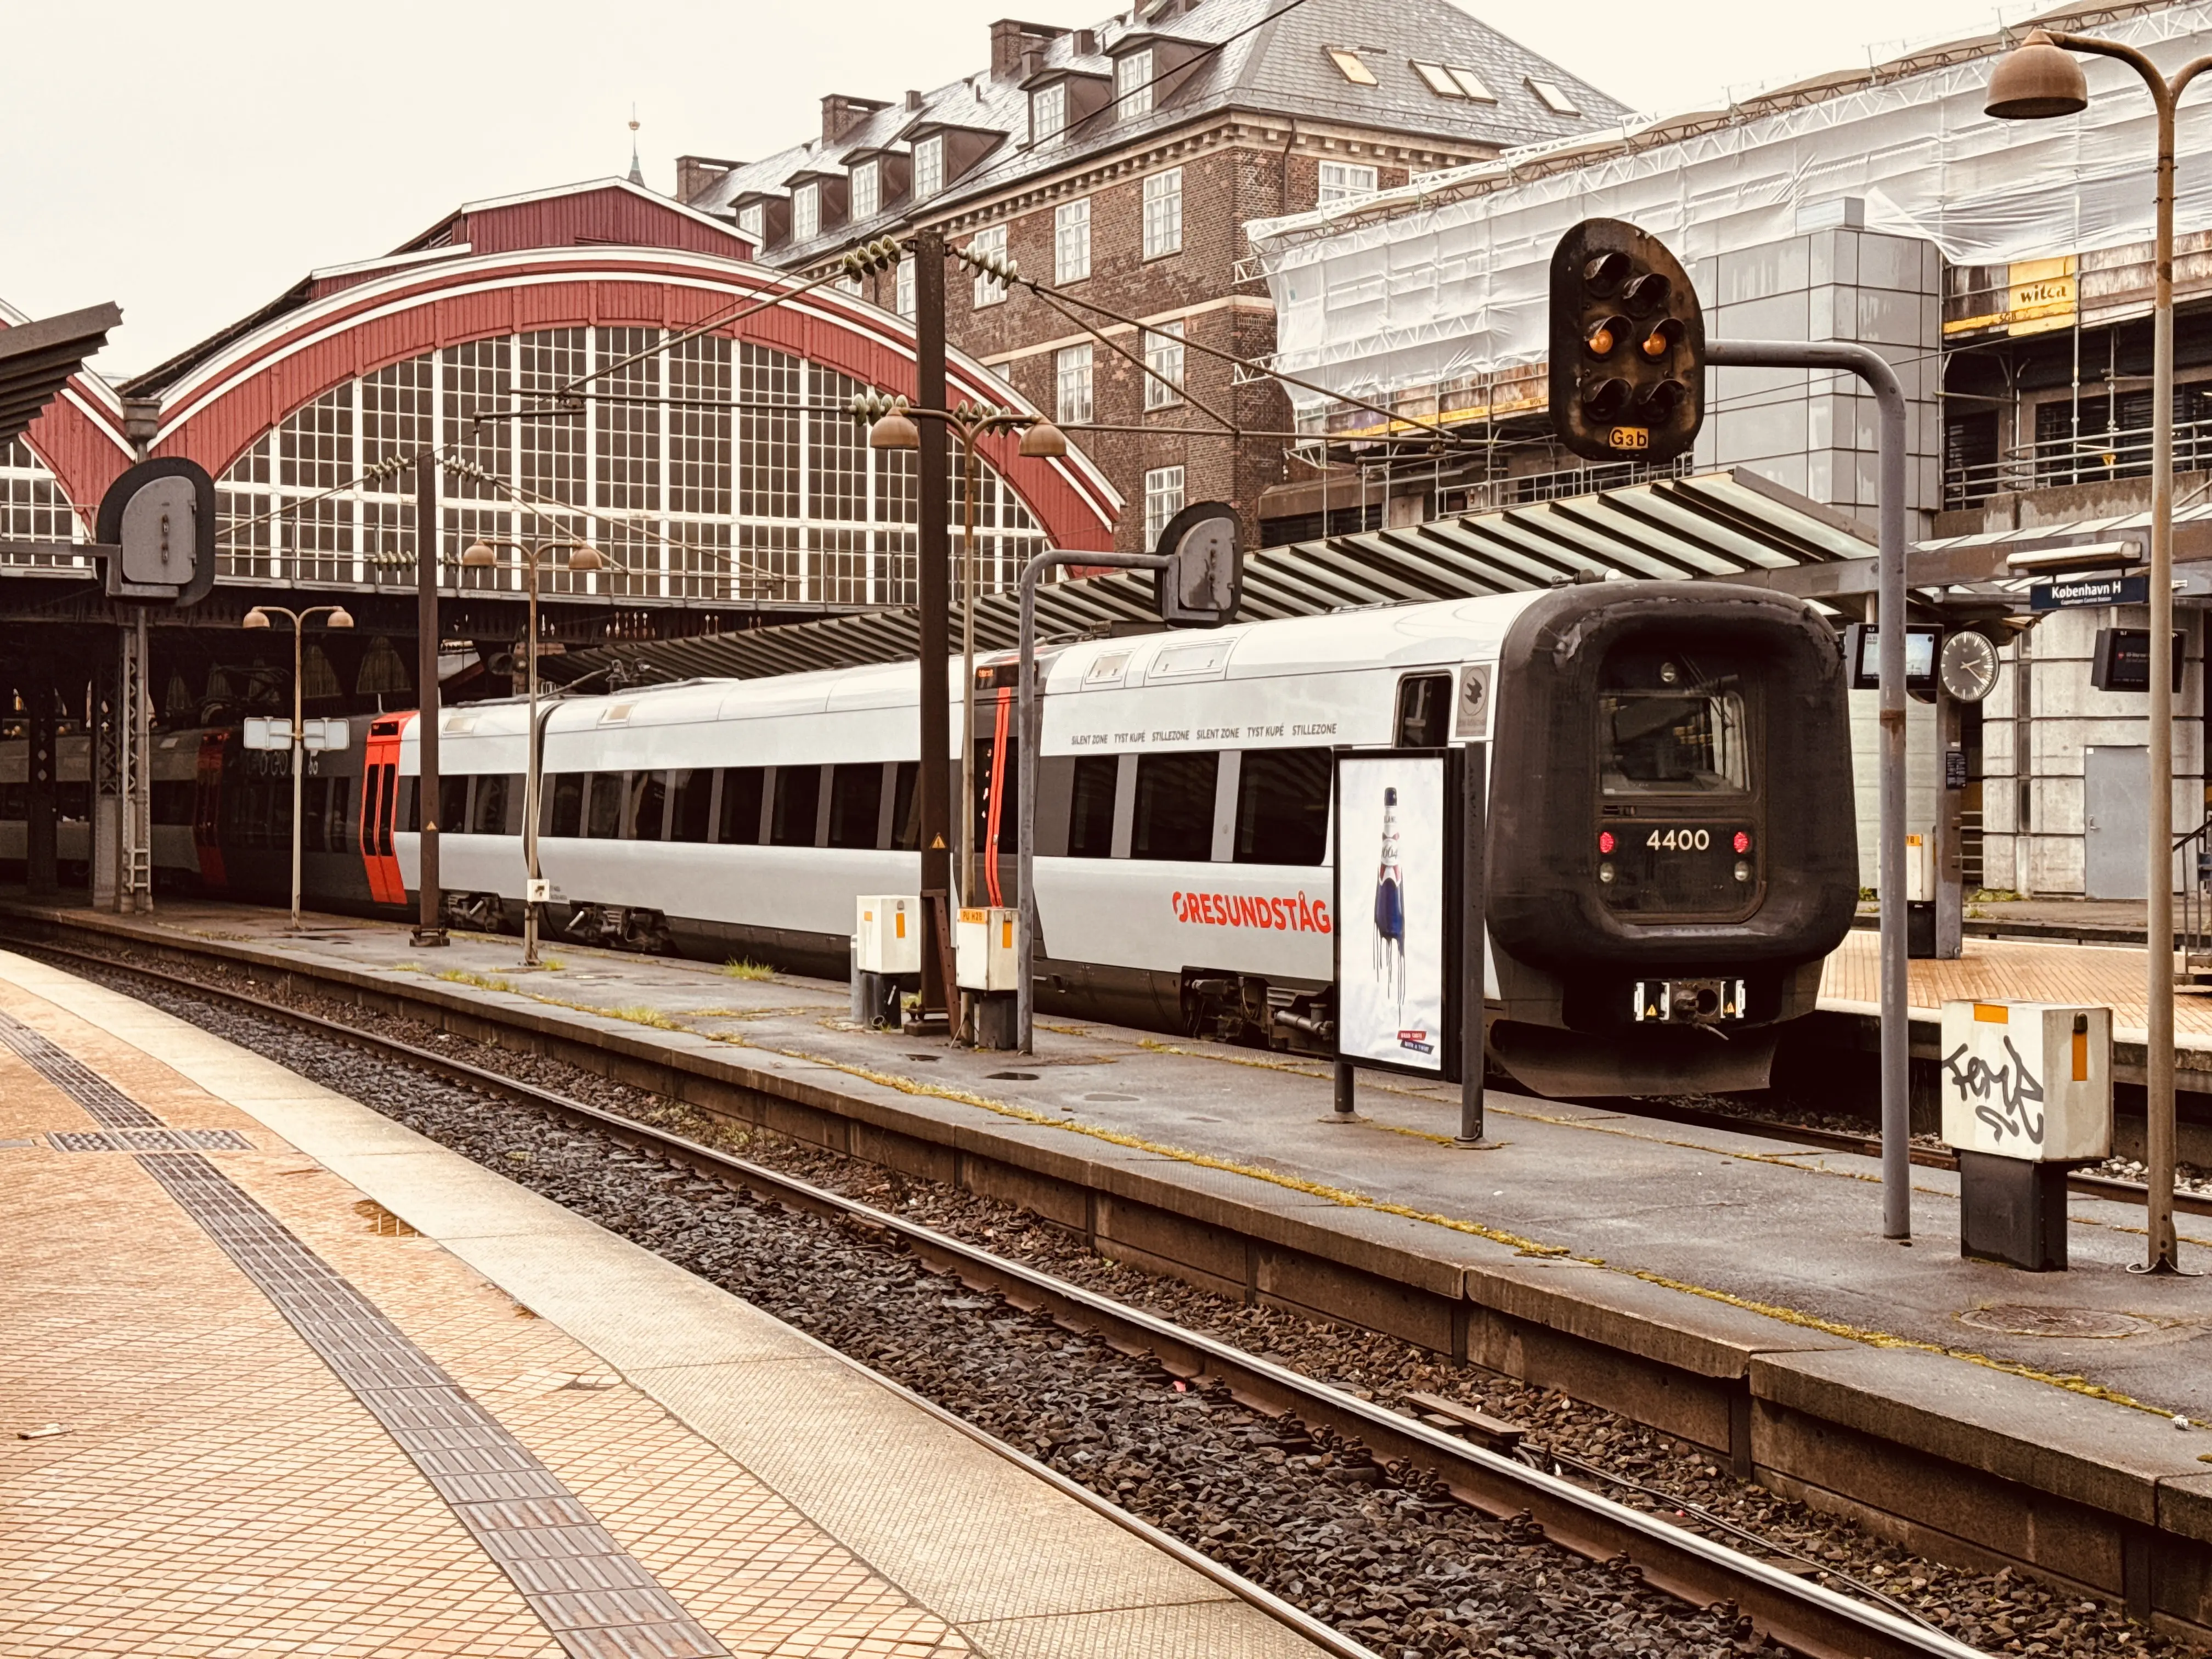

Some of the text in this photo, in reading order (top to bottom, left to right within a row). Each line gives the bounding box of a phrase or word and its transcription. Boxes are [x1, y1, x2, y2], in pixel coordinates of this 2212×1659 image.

[2020, 284, 2067, 302] wilca
[1611, 429, 1647, 447] G3b
[2052, 580, 2121, 599] København H
[1071, 723, 1338, 745] SILENT ZONE TYST KUPÉ STILLEZONE SILENT ZONE TYST KUPÉ STILLEZONE
[1646, 829, 1709, 850] 4400
